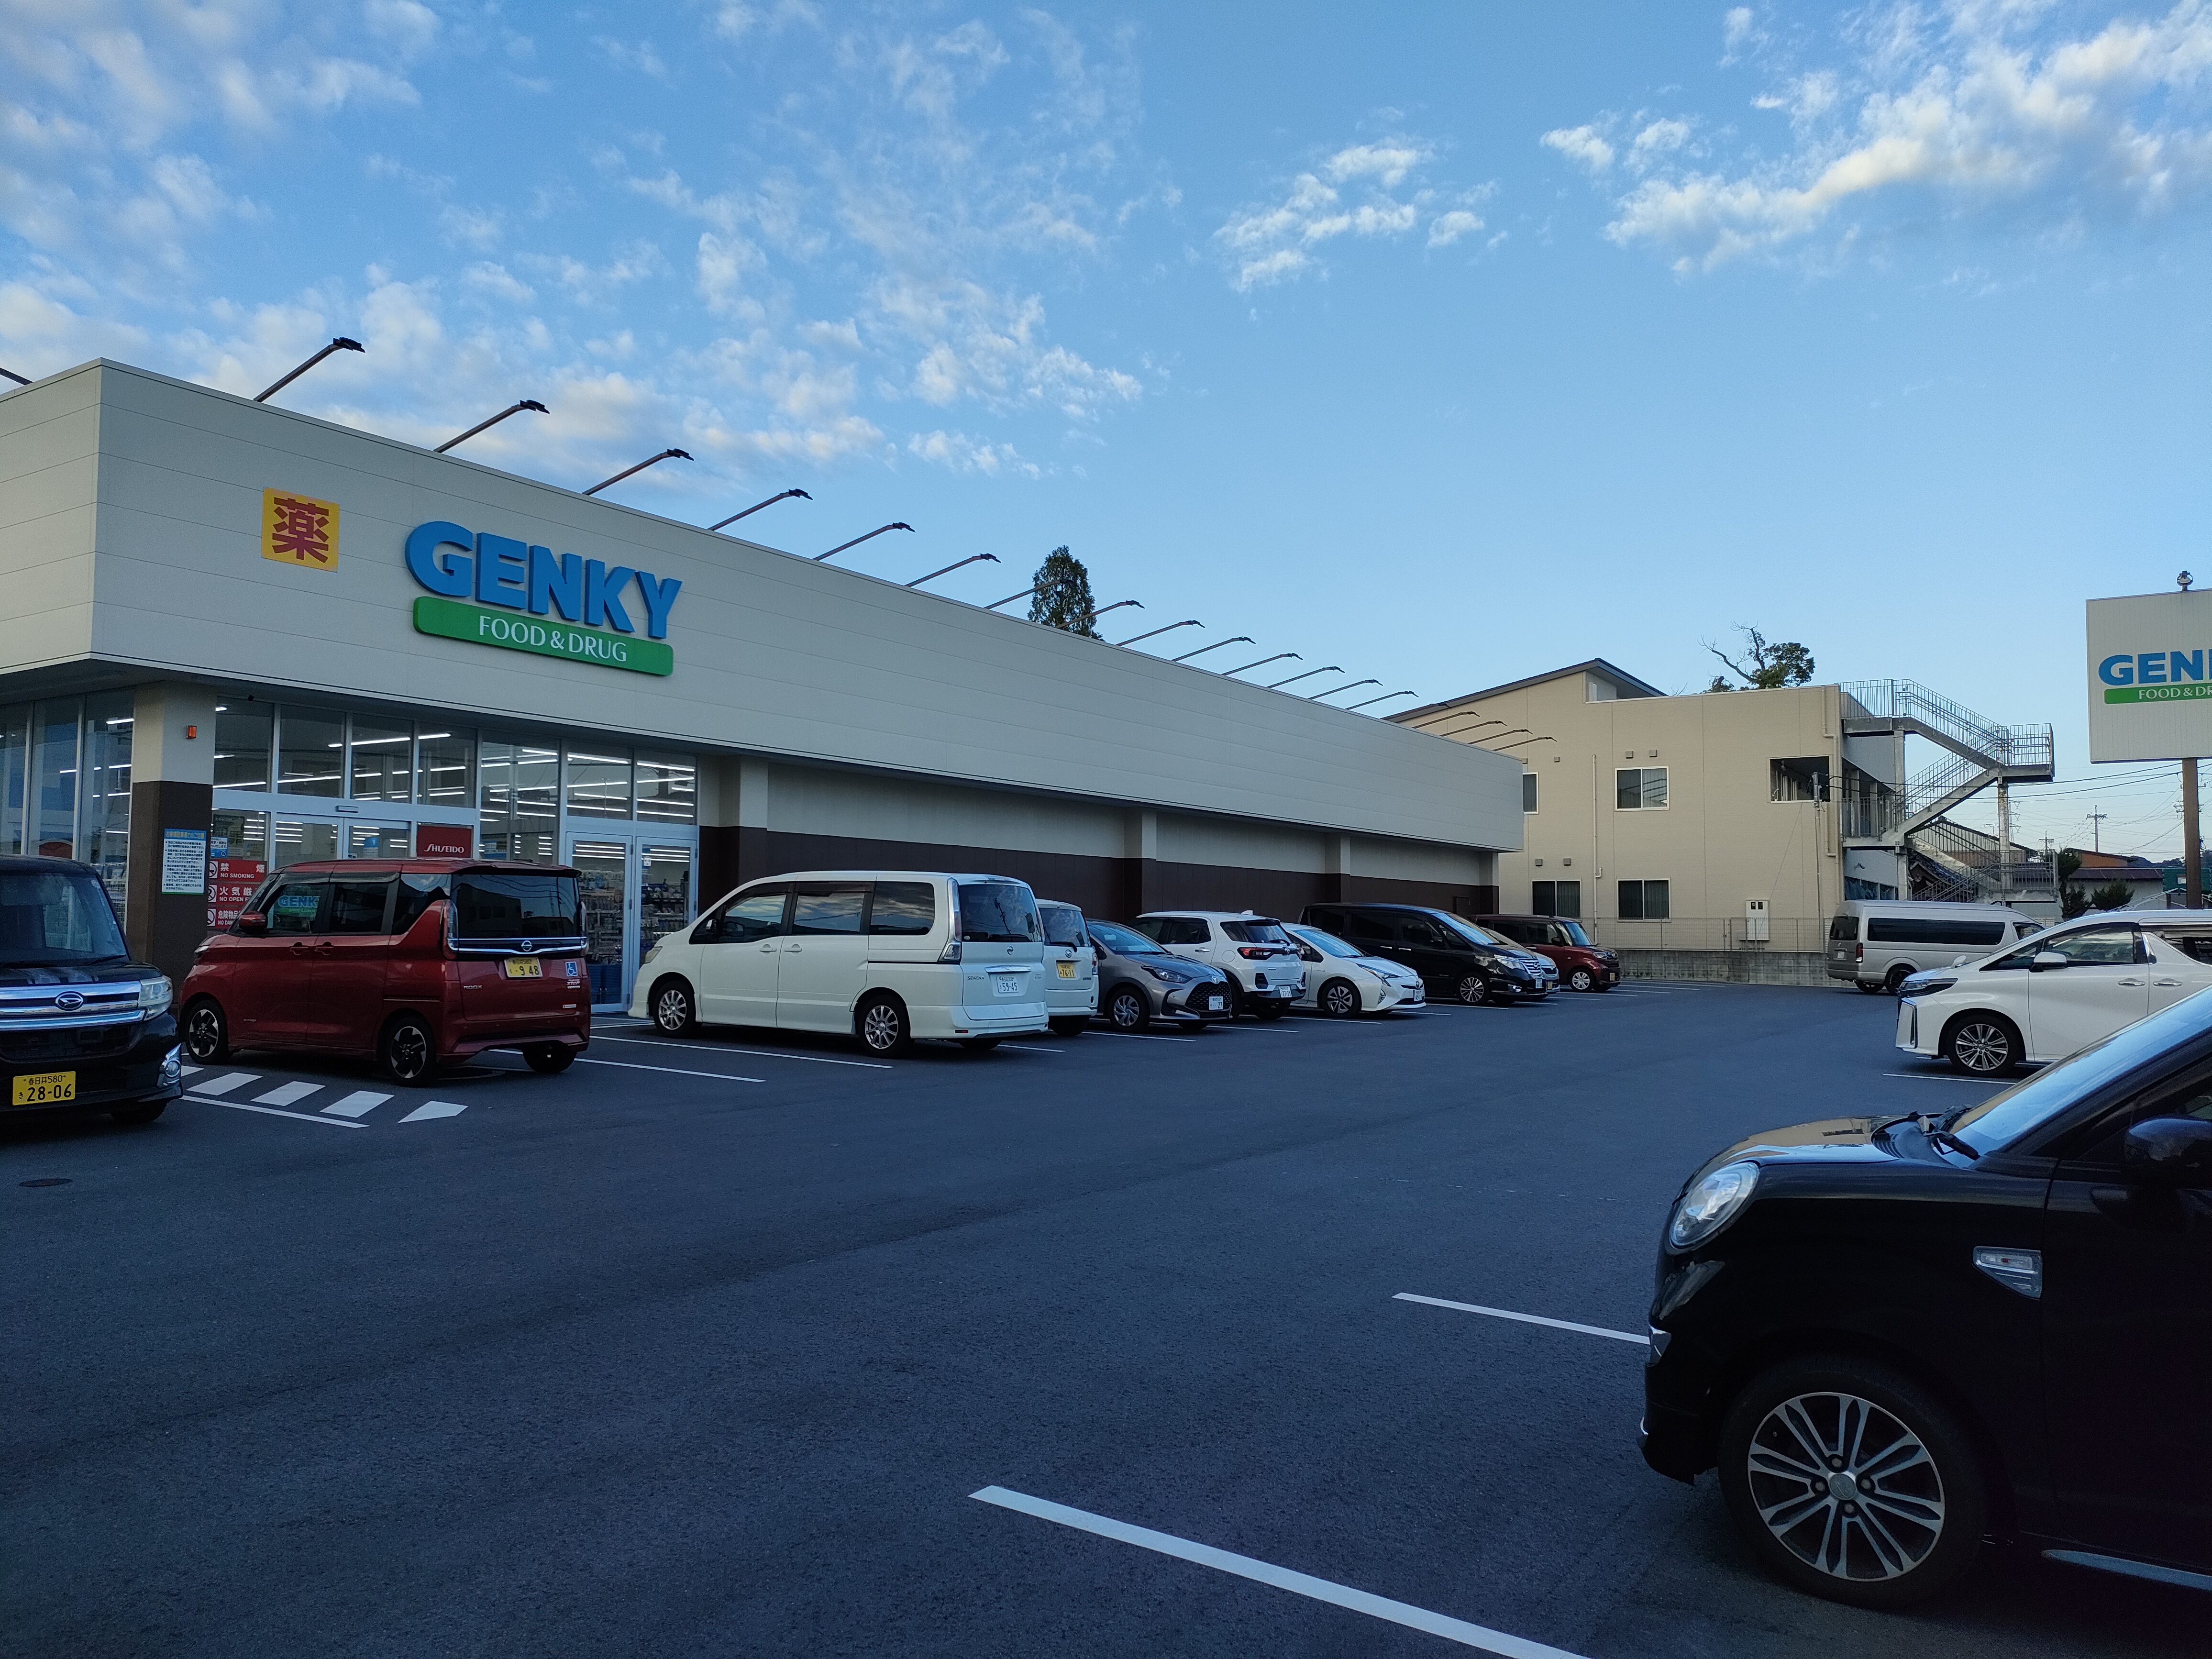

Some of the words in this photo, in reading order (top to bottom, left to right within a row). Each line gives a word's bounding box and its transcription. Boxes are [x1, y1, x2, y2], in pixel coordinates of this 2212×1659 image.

[272, 496, 330, 564] 薬
[405, 521, 683, 639] GENKY
[2098, 649, 2212, 686] GEN
[424, 843, 465, 853] SHISEIDO
[220, 886, 257, 896] 火気厳
[218, 910, 241, 919] 危険物品
[1002, 982, 1018, 991] 59-45
[27, 1084, 72, 1102] 28-06
